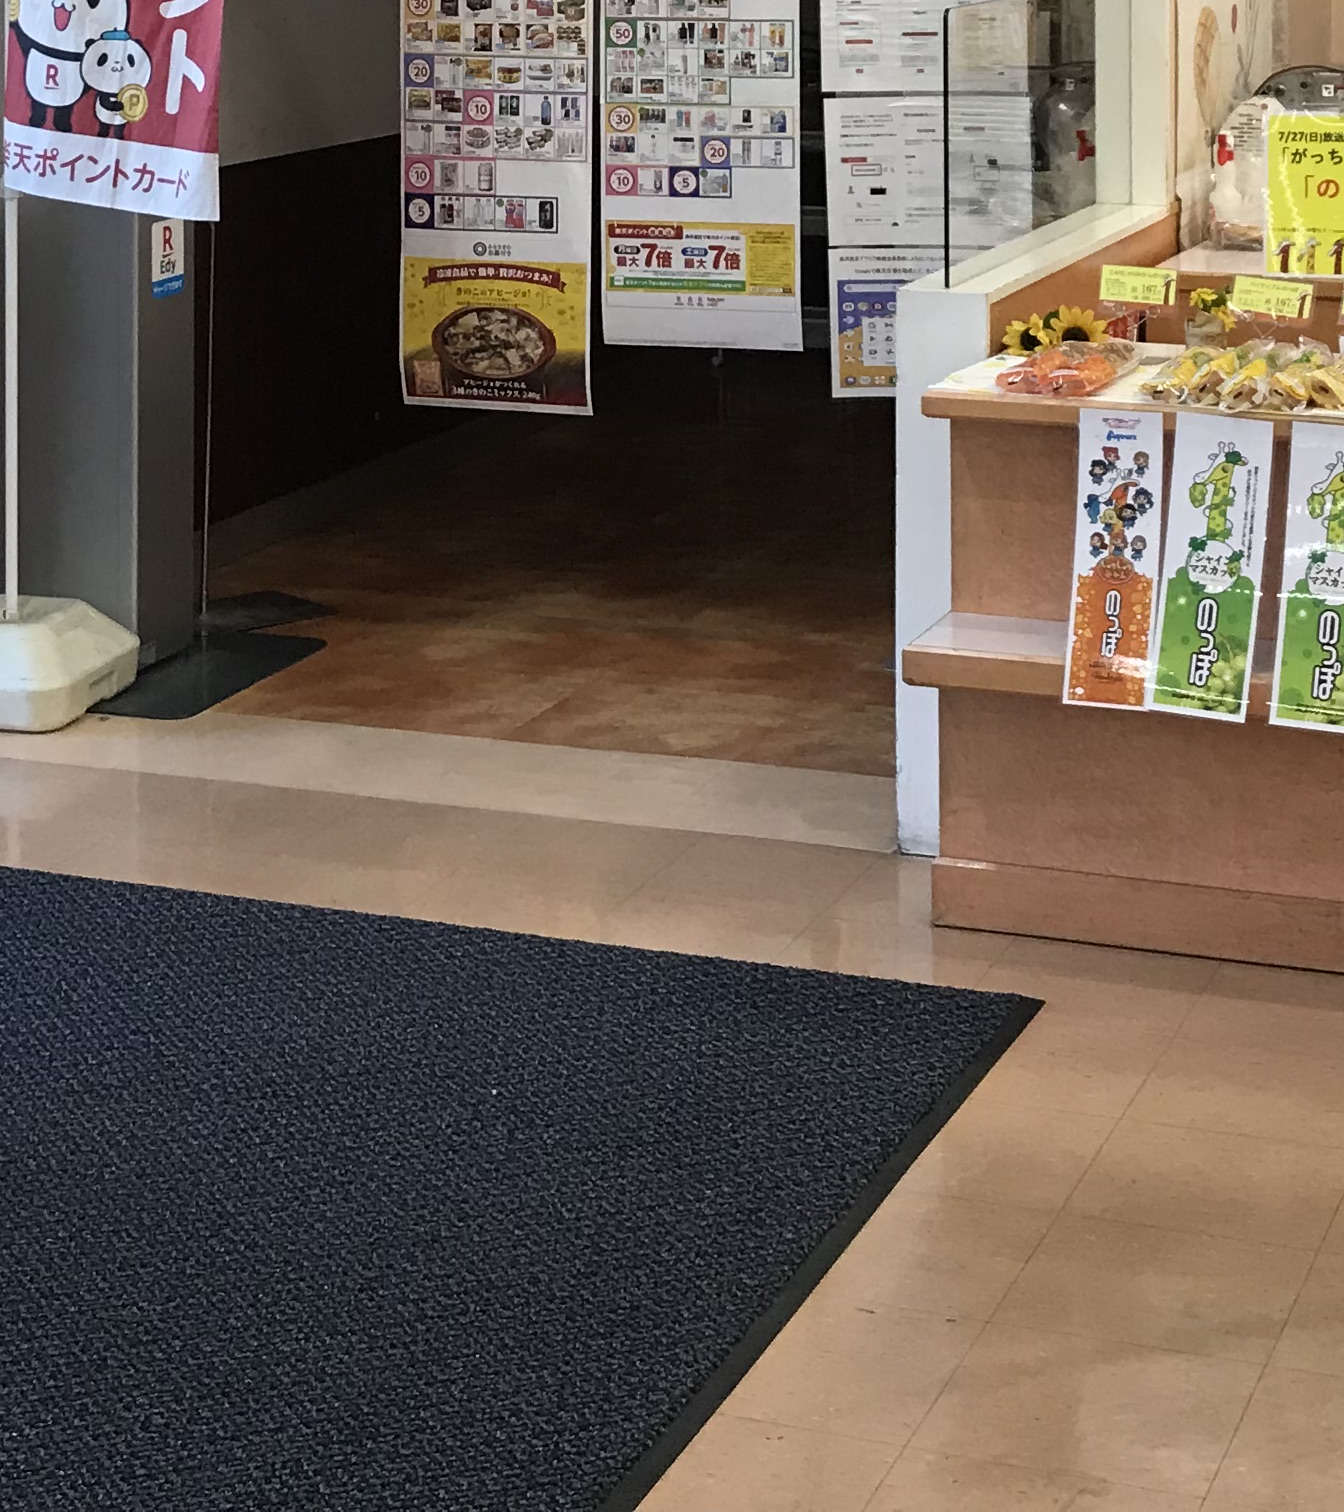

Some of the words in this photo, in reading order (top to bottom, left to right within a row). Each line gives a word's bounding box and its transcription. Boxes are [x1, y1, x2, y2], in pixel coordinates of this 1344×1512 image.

[160, 258, 177, 275] Edy
[1101, 589, 1123, 658] のっぽ
[1188, 598, 1218, 686] のっぽ
[1313, 610, 1342, 701] のっぽ
